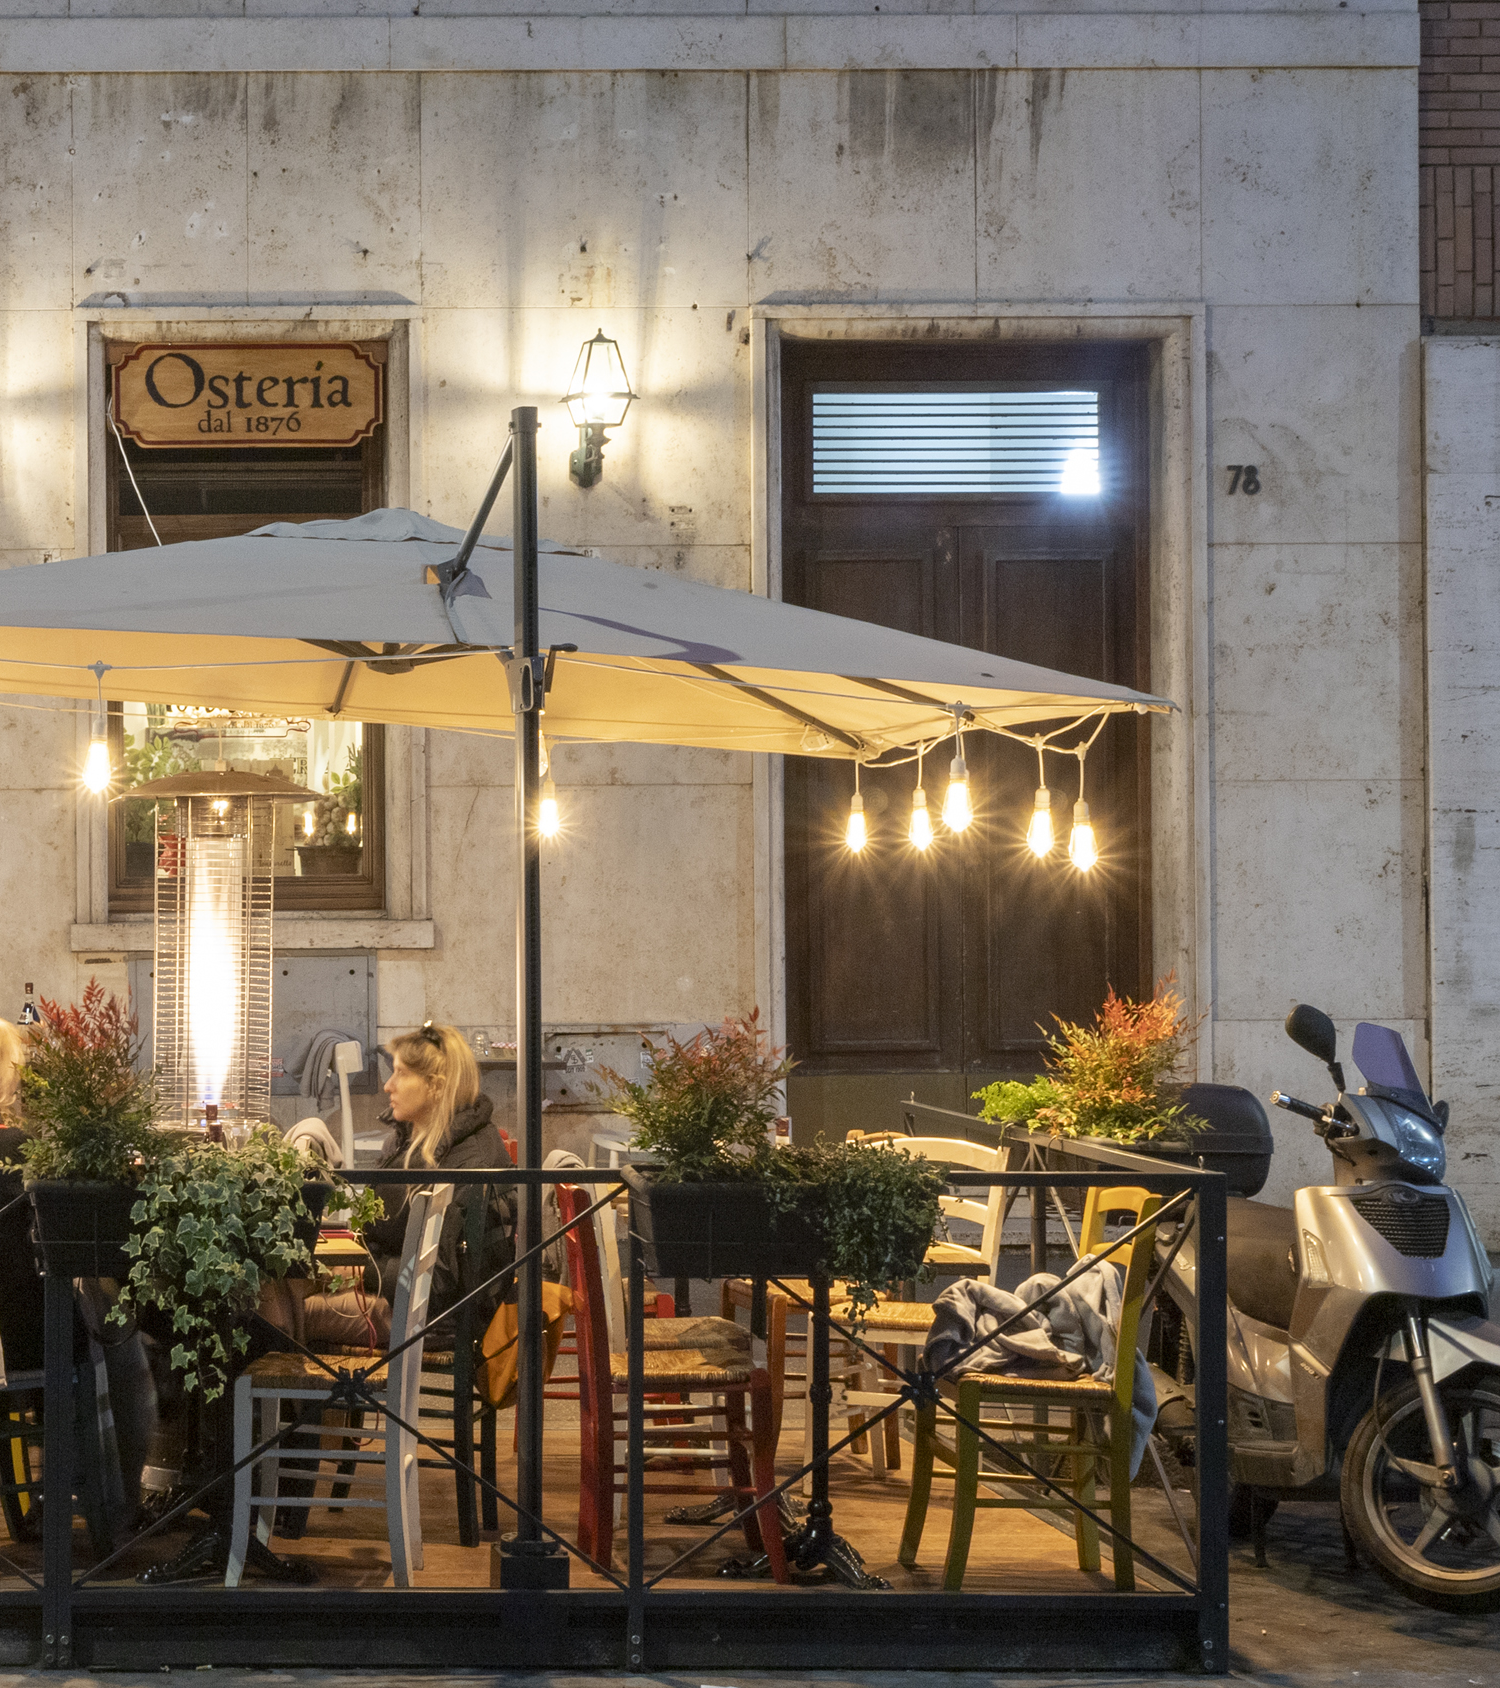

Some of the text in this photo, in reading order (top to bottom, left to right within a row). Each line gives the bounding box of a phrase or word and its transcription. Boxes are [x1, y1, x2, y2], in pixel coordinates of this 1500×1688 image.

[145, 353, 352, 409] Osteria
[197, 410, 302, 436] dal 1876
[1226, 464, 1261, 496] 78
